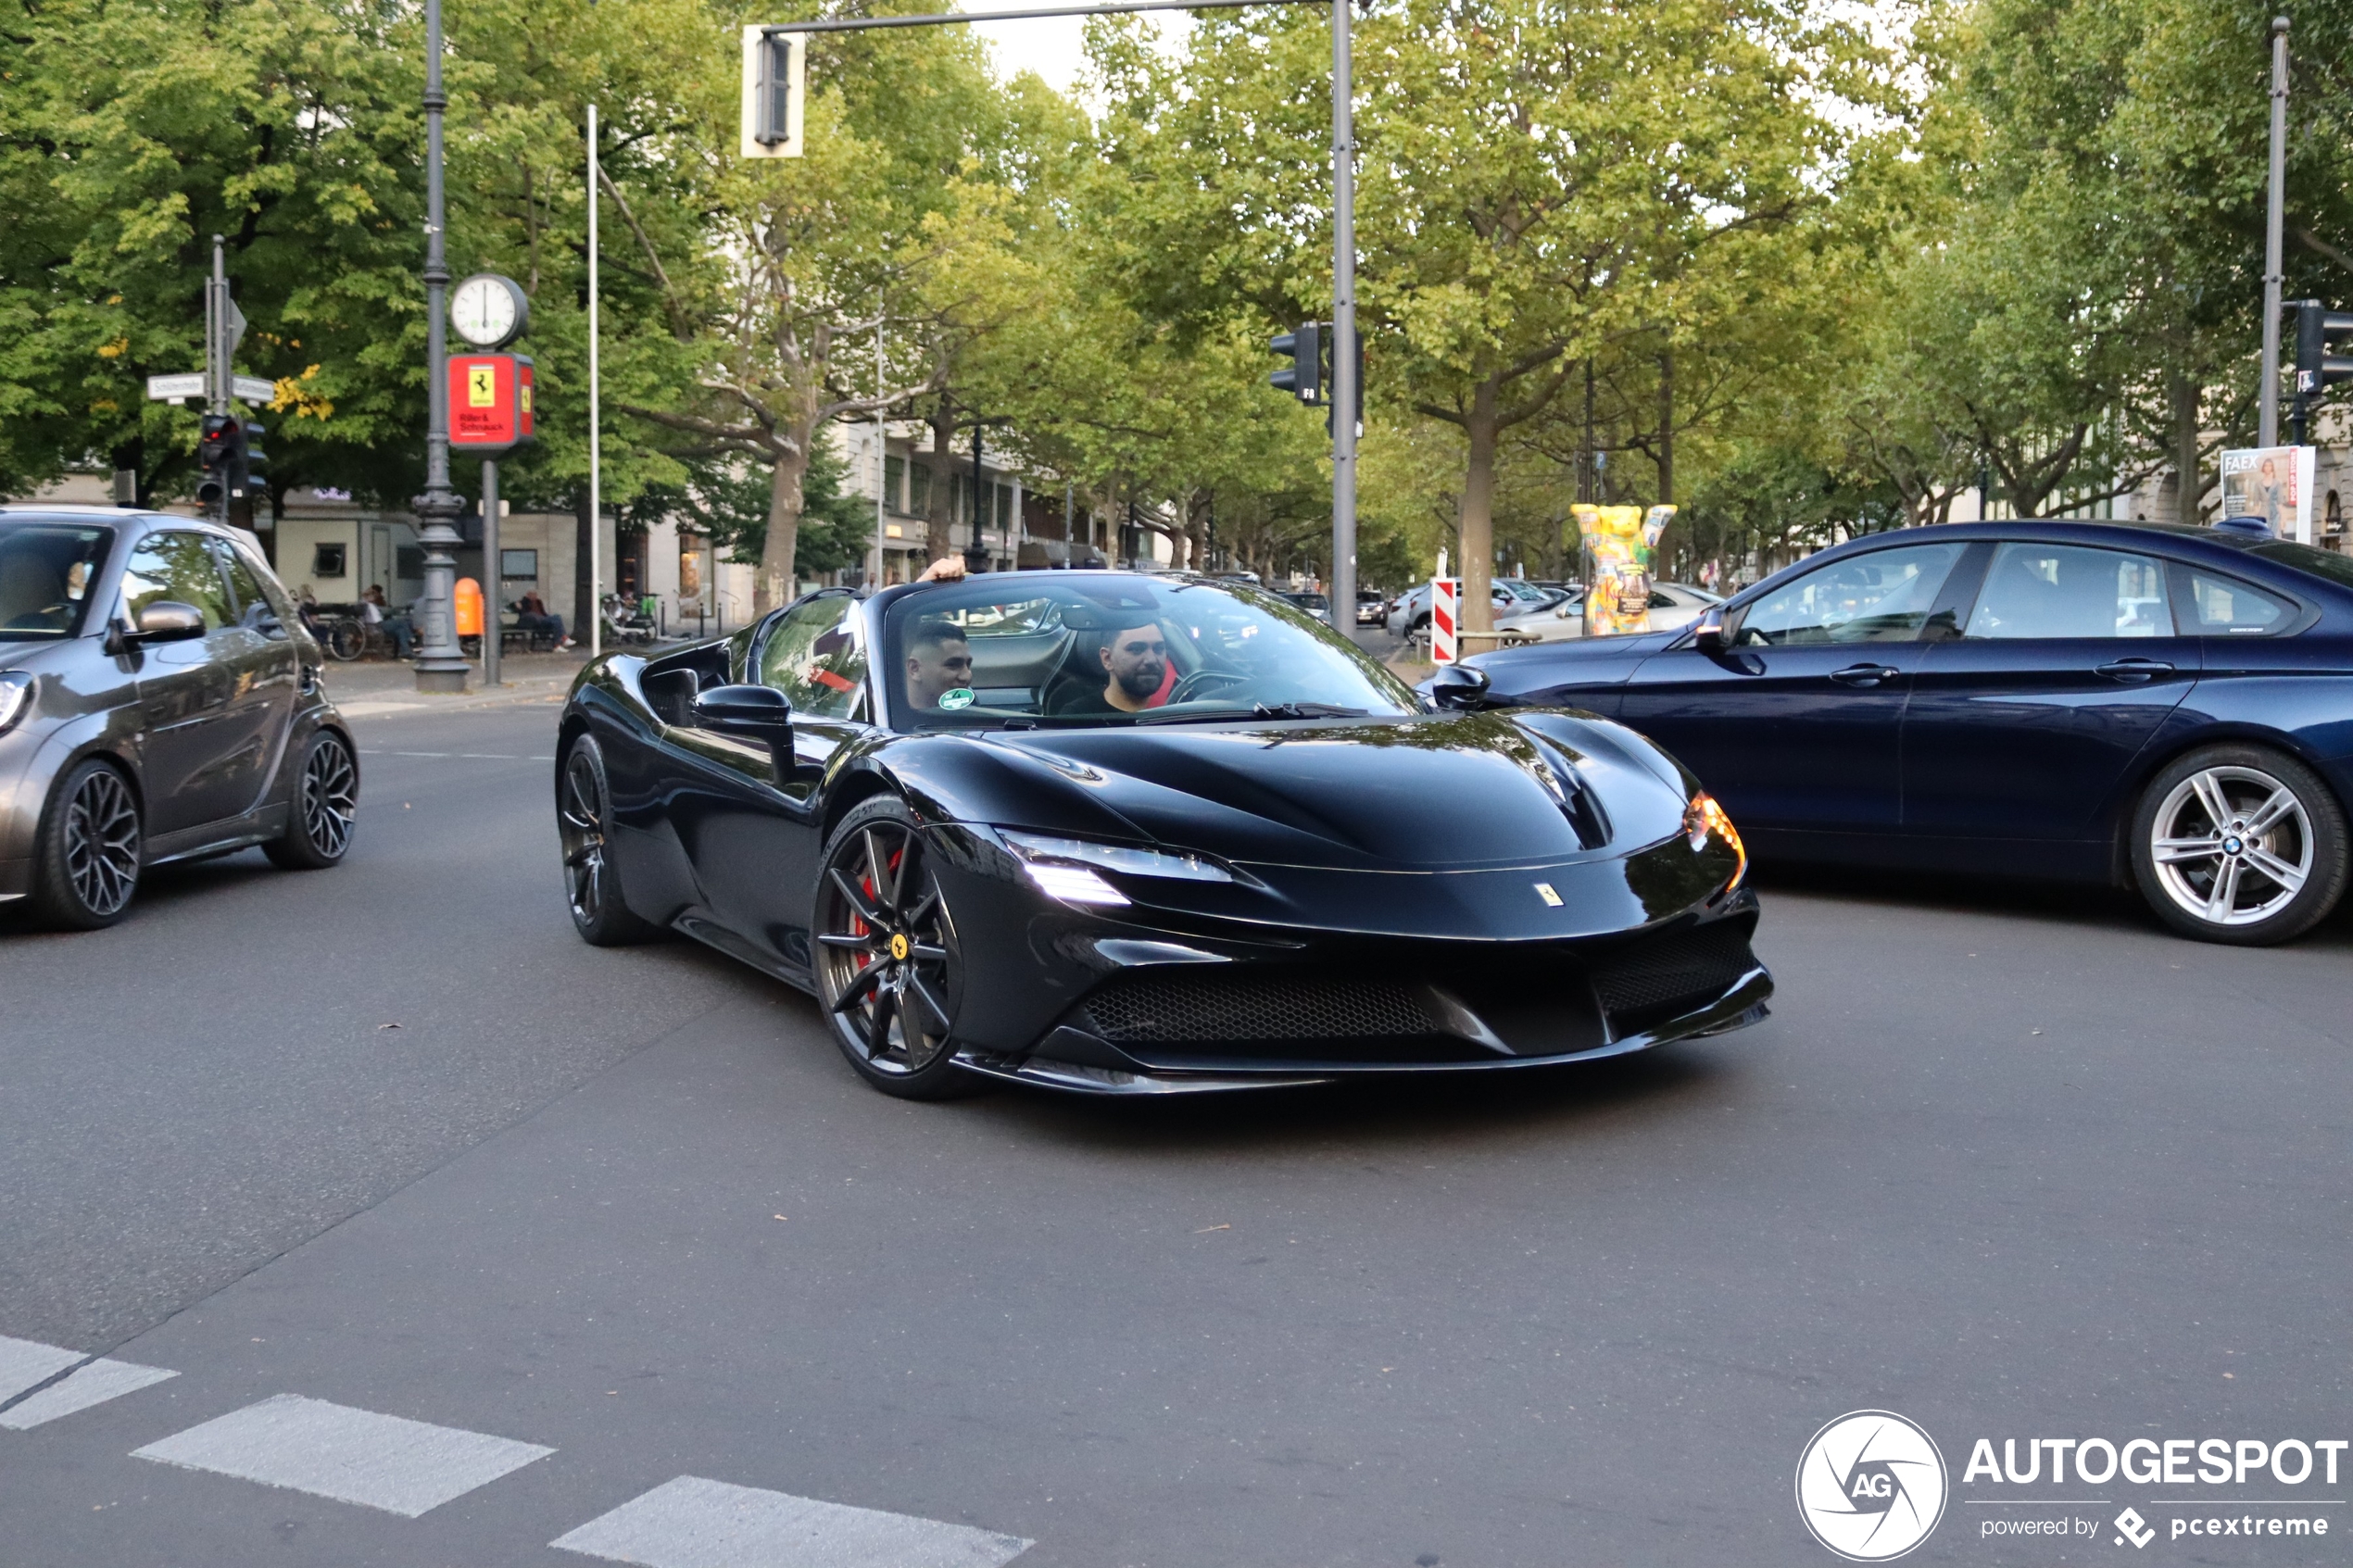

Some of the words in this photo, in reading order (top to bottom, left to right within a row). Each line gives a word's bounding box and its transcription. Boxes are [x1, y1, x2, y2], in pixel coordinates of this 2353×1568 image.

[2225, 455, 2259, 470] FAEX
[2289, 451, 2297, 474] STORE
[2289, 474, 2297, 485] UP
[2289, 486, 2297, 501] POP
